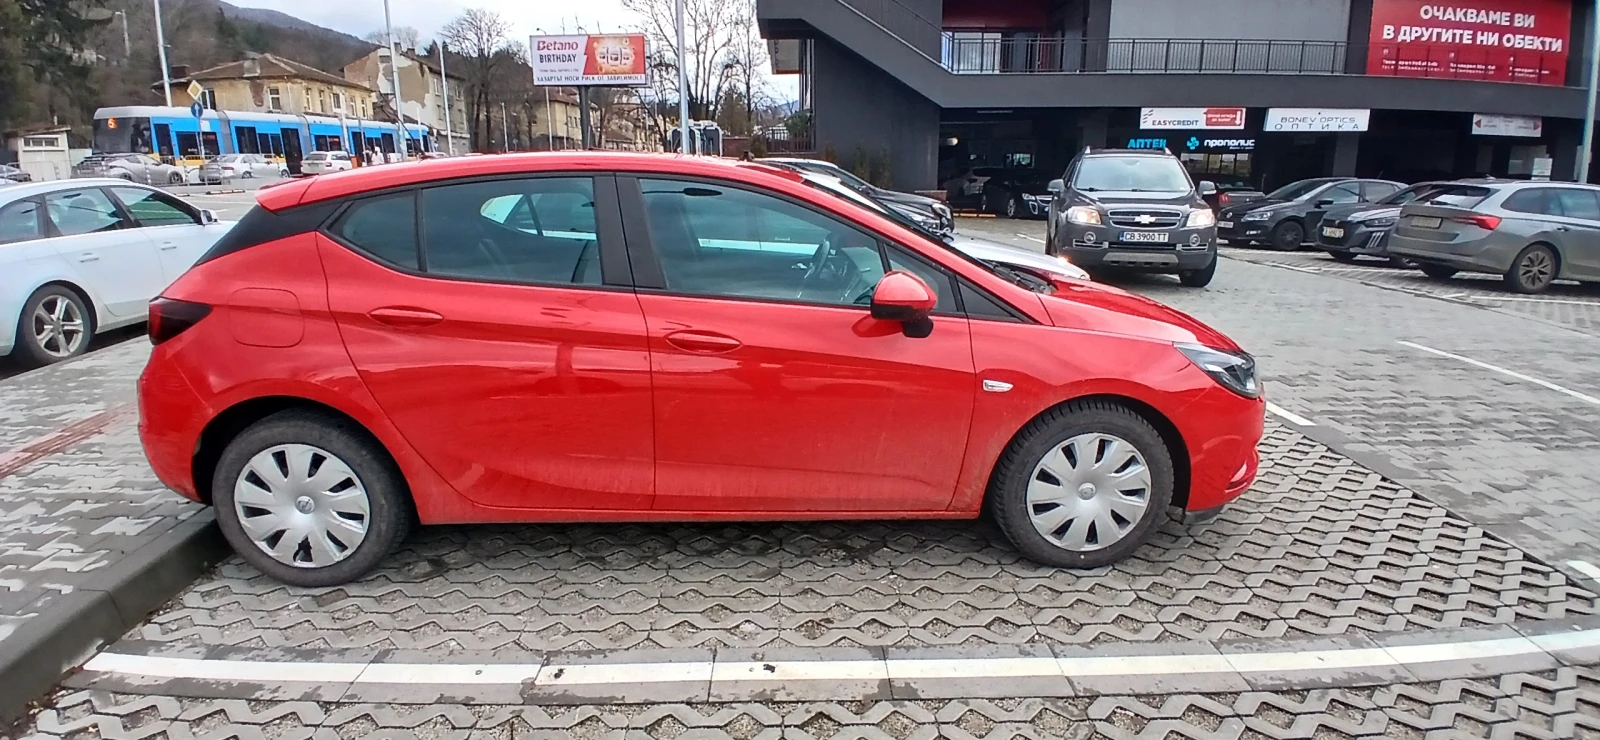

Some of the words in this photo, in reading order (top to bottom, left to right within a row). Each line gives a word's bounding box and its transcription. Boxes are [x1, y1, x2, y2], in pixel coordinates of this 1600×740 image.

[1420, 5, 1511, 26] ОЧАКВАМЕ
[1514, 13, 1535, 28] ВИ
[537, 40, 578, 51] Betano
[1383, 25, 1395, 39] В
[1398, 27, 1473, 44] ДРУГИТЕ
[1477, 32, 1499, 46] НИ
[1503, 34, 1562, 52] ОБЕКТИ
[540, 54, 577, 63] BIRTHDAY
